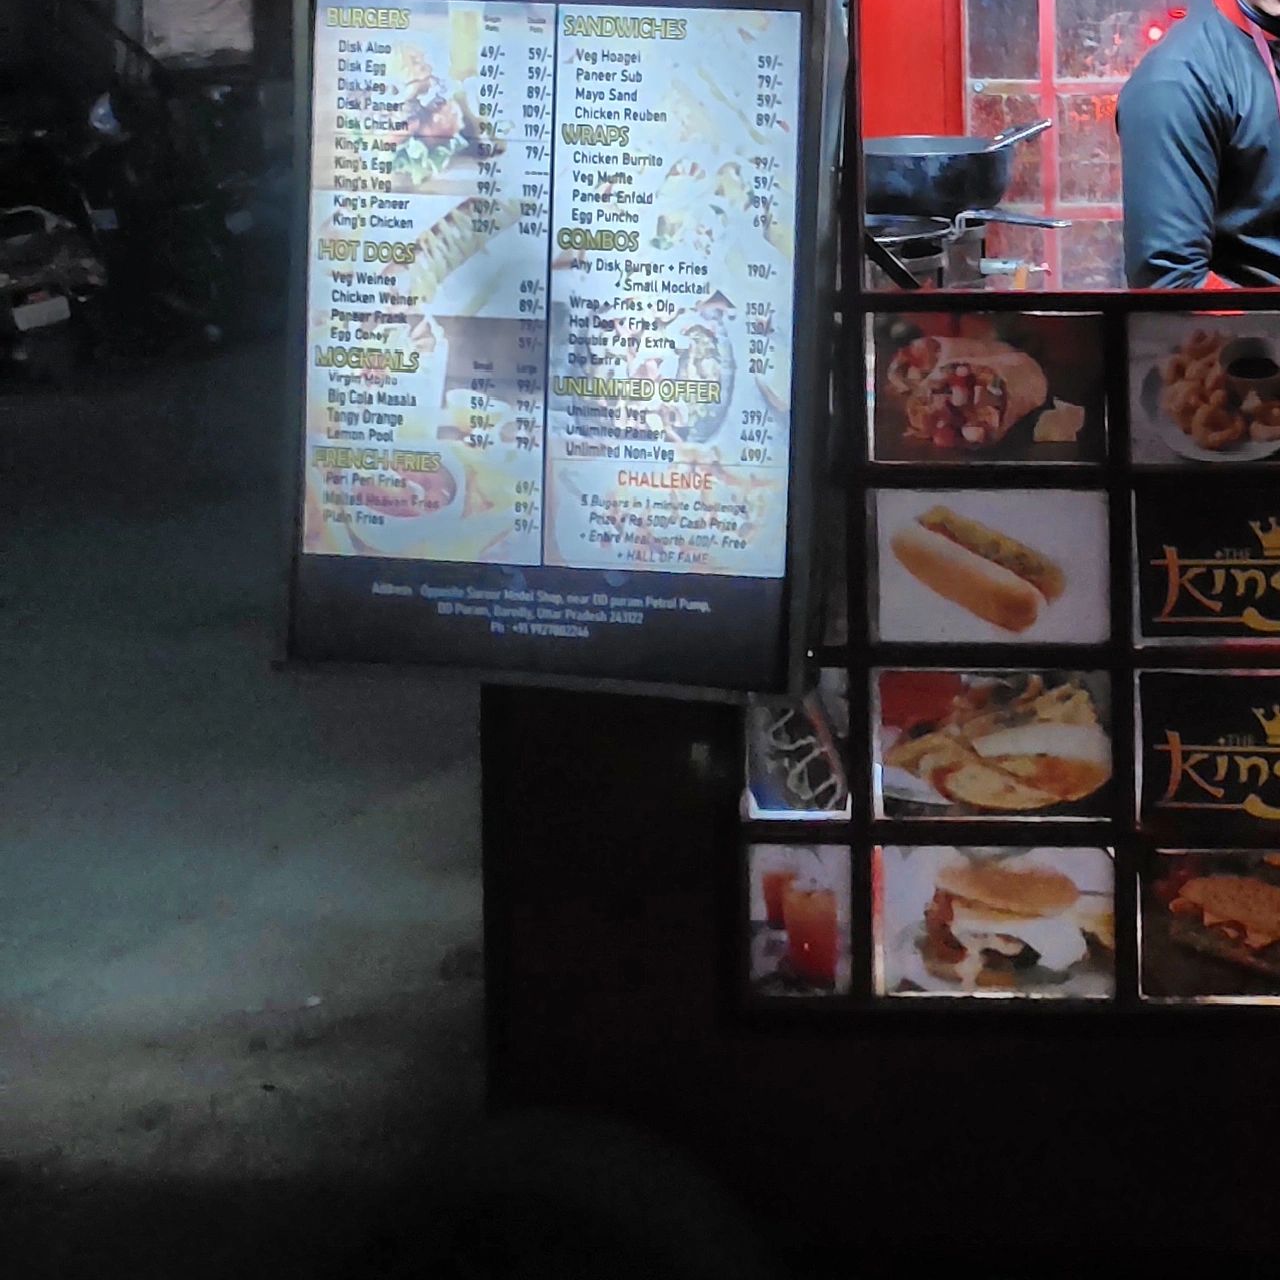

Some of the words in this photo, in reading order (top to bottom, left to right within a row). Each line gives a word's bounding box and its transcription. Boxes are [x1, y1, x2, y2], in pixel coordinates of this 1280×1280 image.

[326, 7, 411, 29] BURGERS
[563, 14, 687, 40] SANDWICHES
[339, 40, 362, 53] Disk
[480, 45, 505, 58] 49/-
[528, 47, 552, 61] 59/-
[576, 48, 597, 65] Veg
[758, 55, 783, 69] 59/-
[338, 59, 361, 72] Disk
[365, 60, 386, 76] Egg
[528, 66, 552, 80] 59/-
[576, 68, 617, 82] Paneer
[621, 69, 643, 83] Sub
[757, 75, 782, 88] 79/-
[480, 84, 503, 98] 69/-
[527, 85, 551, 99] 89/-
[575, 87, 605, 103] Mayo
[609, 89, 637, 102] Sand
[757, 94, 782, 107] 59/-
[337, 97, 360, 110] Disk
[365, 98, 404, 112] Paneer
[522, 104, 550, 118] 109/-
[575, 106, 620, 120] Chicken
[624, 108, 666, 122] Reuben
[337, 116, 360, 129] Disk
[364, 118, 408, 131] Chicken
[525, 123, 550, 138] 119/-
[562, 123, 629, 147] WRAPS
[335, 137, 367, 154] King's
[526, 145, 550, 161] 79/-
[573, 151, 618, 165] Chicken
[623, 153, 663, 167] Burrito
[334, 157, 367, 172] King's
[371, 158, 392, 173] Egg
[479, 161, 501, 176] 79/-
[334, 175, 367, 192] King's
[371, 177, 392, 193] Veg
[477, 181, 501, 196] 99/-
[522, 183, 548, 198] 119/-
[573, 170, 594, 185] Veg
[754, 176, 779, 189] 59/-
[334, 194, 366, 211] King's
[370, 196, 410, 210] Paneer
[333, 213, 366, 229] King's
[370, 215, 413, 229] Chicken
[519, 221, 547, 235] 149/-
[572, 208, 593, 224] Egg
[557, 228, 640, 252] COMBOS
[318, 239, 360, 261] HOT
[363, 241, 416, 264] DOGS
[570, 258, 593, 273] Any
[596, 258, 621, 272] Disk
[624, 260, 664, 277] Burger
[679, 262, 708, 276] Fries
[748, 264, 777, 279] 190/-
[332, 271, 353, 287] Veg
[520, 280, 544, 294] 69/-
[623, 280, 657, 293] Small
[661, 282, 710, 295] Mocktail
[332, 290, 375, 303] Chicken
[519, 299, 544, 313] 89/-
[570, 296, 600, 313] Wrap
[614, 298, 642, 312] Fries
[656, 299, 675, 315] Dip
[330, 327, 351, 341] Egg
[629, 319, 658, 331] Fries
[645, 337, 676, 350] Extra
[749, 340, 775, 354] 30/-
[315, 345, 419, 372] MOCKTAILS
[749, 358, 774, 374] 20/-
[553, 376, 654, 399] UNLIMITED
[658, 380, 721, 404] OFFER
[328, 388, 345, 405] Big
[470, 395, 495, 410] 59/-
[516, 400, 541, 414] 79/-
[327, 407, 359, 425] Tangy
[362, 409, 404, 426] Orange
[470, 415, 495, 429] 59/-
[567, 404, 621, 419] Unlimited
[368, 428, 394, 442] Pool
[313, 445, 389, 470] FRENCH
[391, 450, 441, 472] FRIES
[566, 443, 620, 458] Unlimited
[378, 475, 407, 488] Fries
[515, 481, 539, 495] 69/-
[618, 470, 713, 489] CHALLENGE
[355, 511, 384, 525] Fries
[515, 520, 538, 534] 59/-
[679, 516, 706, 529] Cash
[721, 537, 747, 549] Free
[626, 552, 655, 563] HALL
